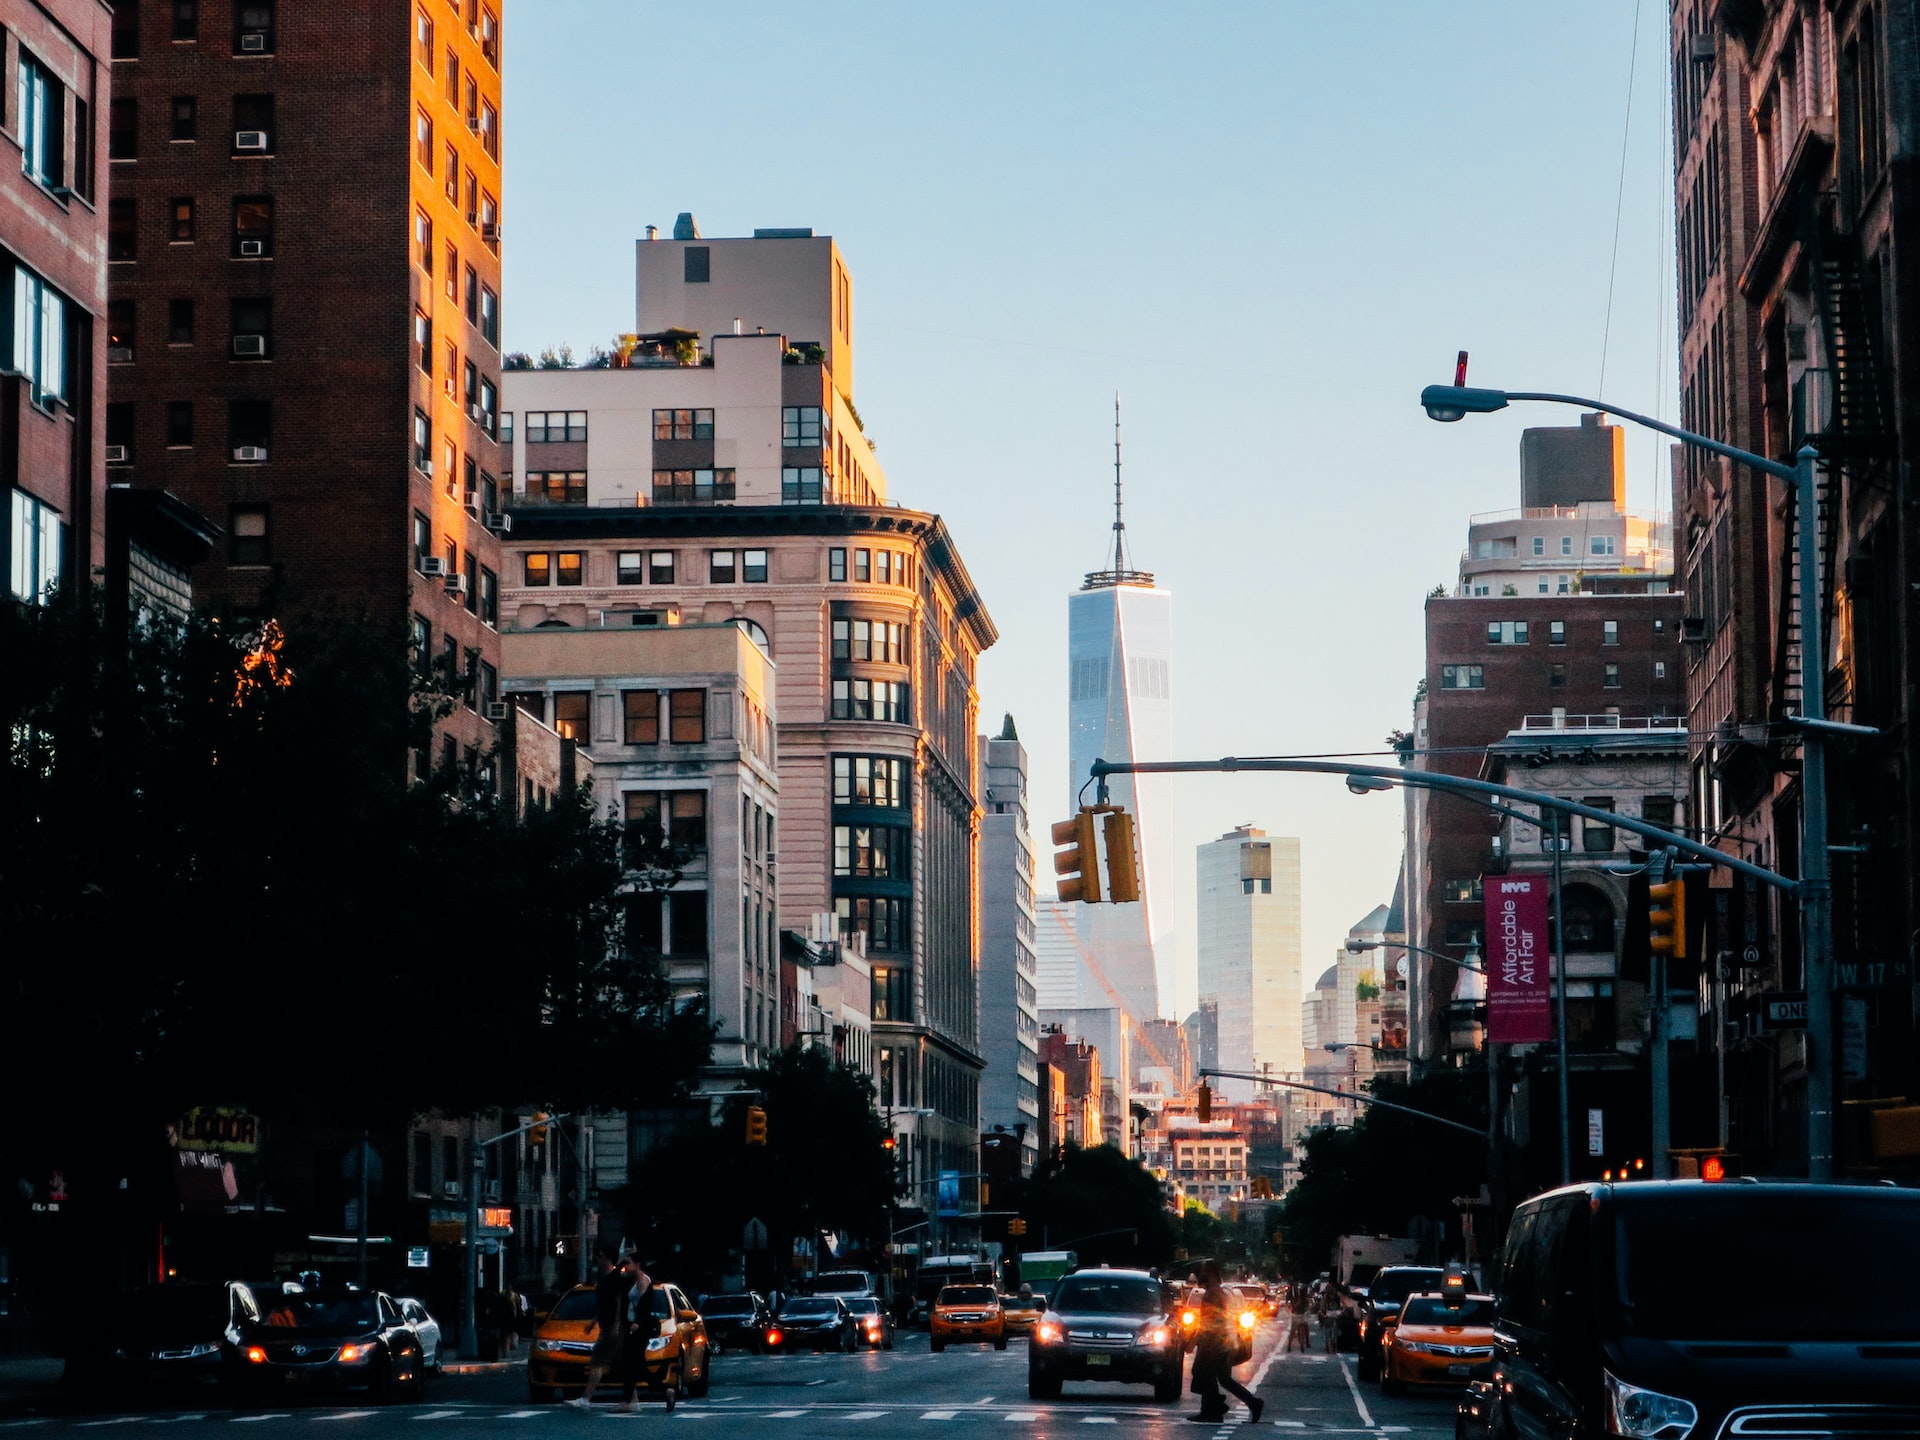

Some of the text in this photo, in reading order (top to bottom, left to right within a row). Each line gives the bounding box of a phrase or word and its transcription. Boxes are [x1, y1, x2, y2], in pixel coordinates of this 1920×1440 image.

[1501, 882, 1531, 893] NYC
[1501, 900, 1518, 985] Affordable
[1518, 930, 1535, 985] Art Fair
[1841, 963, 1857, 984] W
[1868, 963, 1885, 984] 17
[1778, 1003, 1808, 1018] ONE
